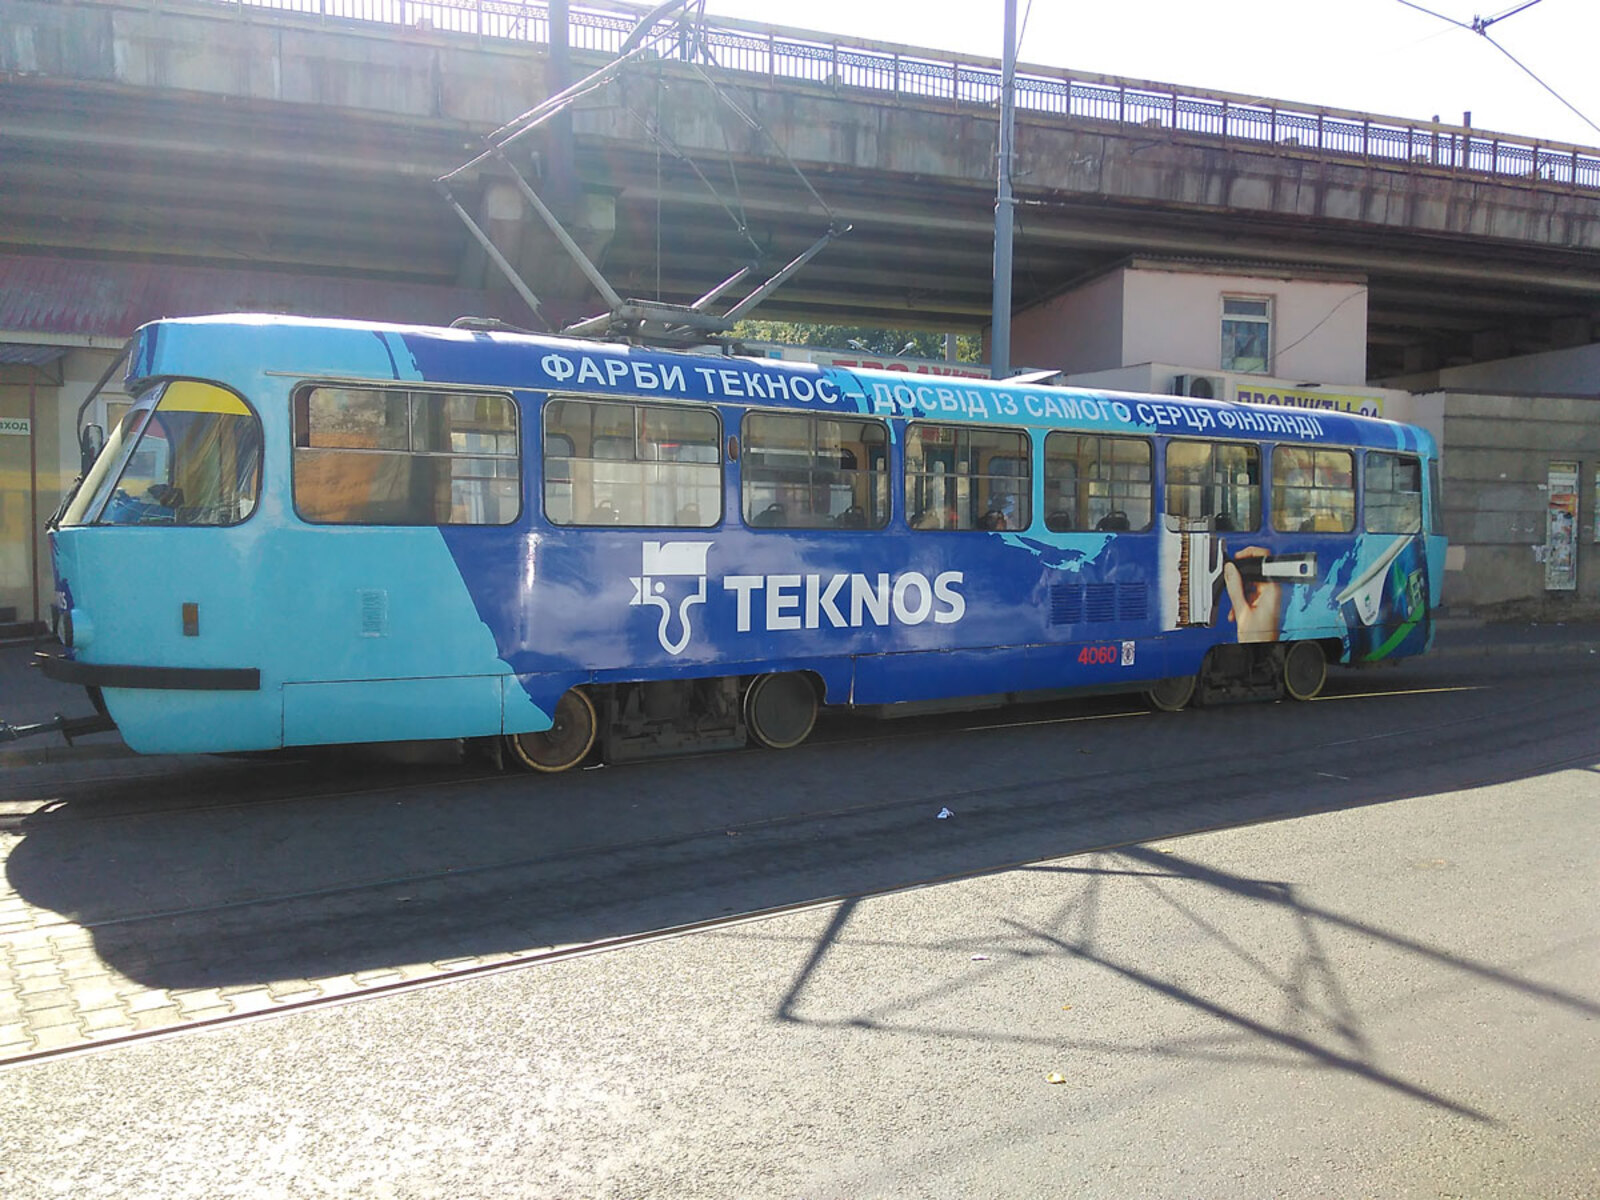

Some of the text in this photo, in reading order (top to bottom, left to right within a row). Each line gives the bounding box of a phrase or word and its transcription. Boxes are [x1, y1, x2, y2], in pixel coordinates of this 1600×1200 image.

[541, 353, 686, 392] ФАРБИ
[694, 367, 838, 404] ТЕКНОС
[872, 383, 989, 418] ДОСВІД
[991, 391, 1019, 415] ІЗ
[1024, 395, 1132, 423] САМОГО
[1136, 403, 1217, 432] СЕРЦЯ
[723, 571, 967, 632] TEKNOS
[1077, 645, 1118, 665] 4060
